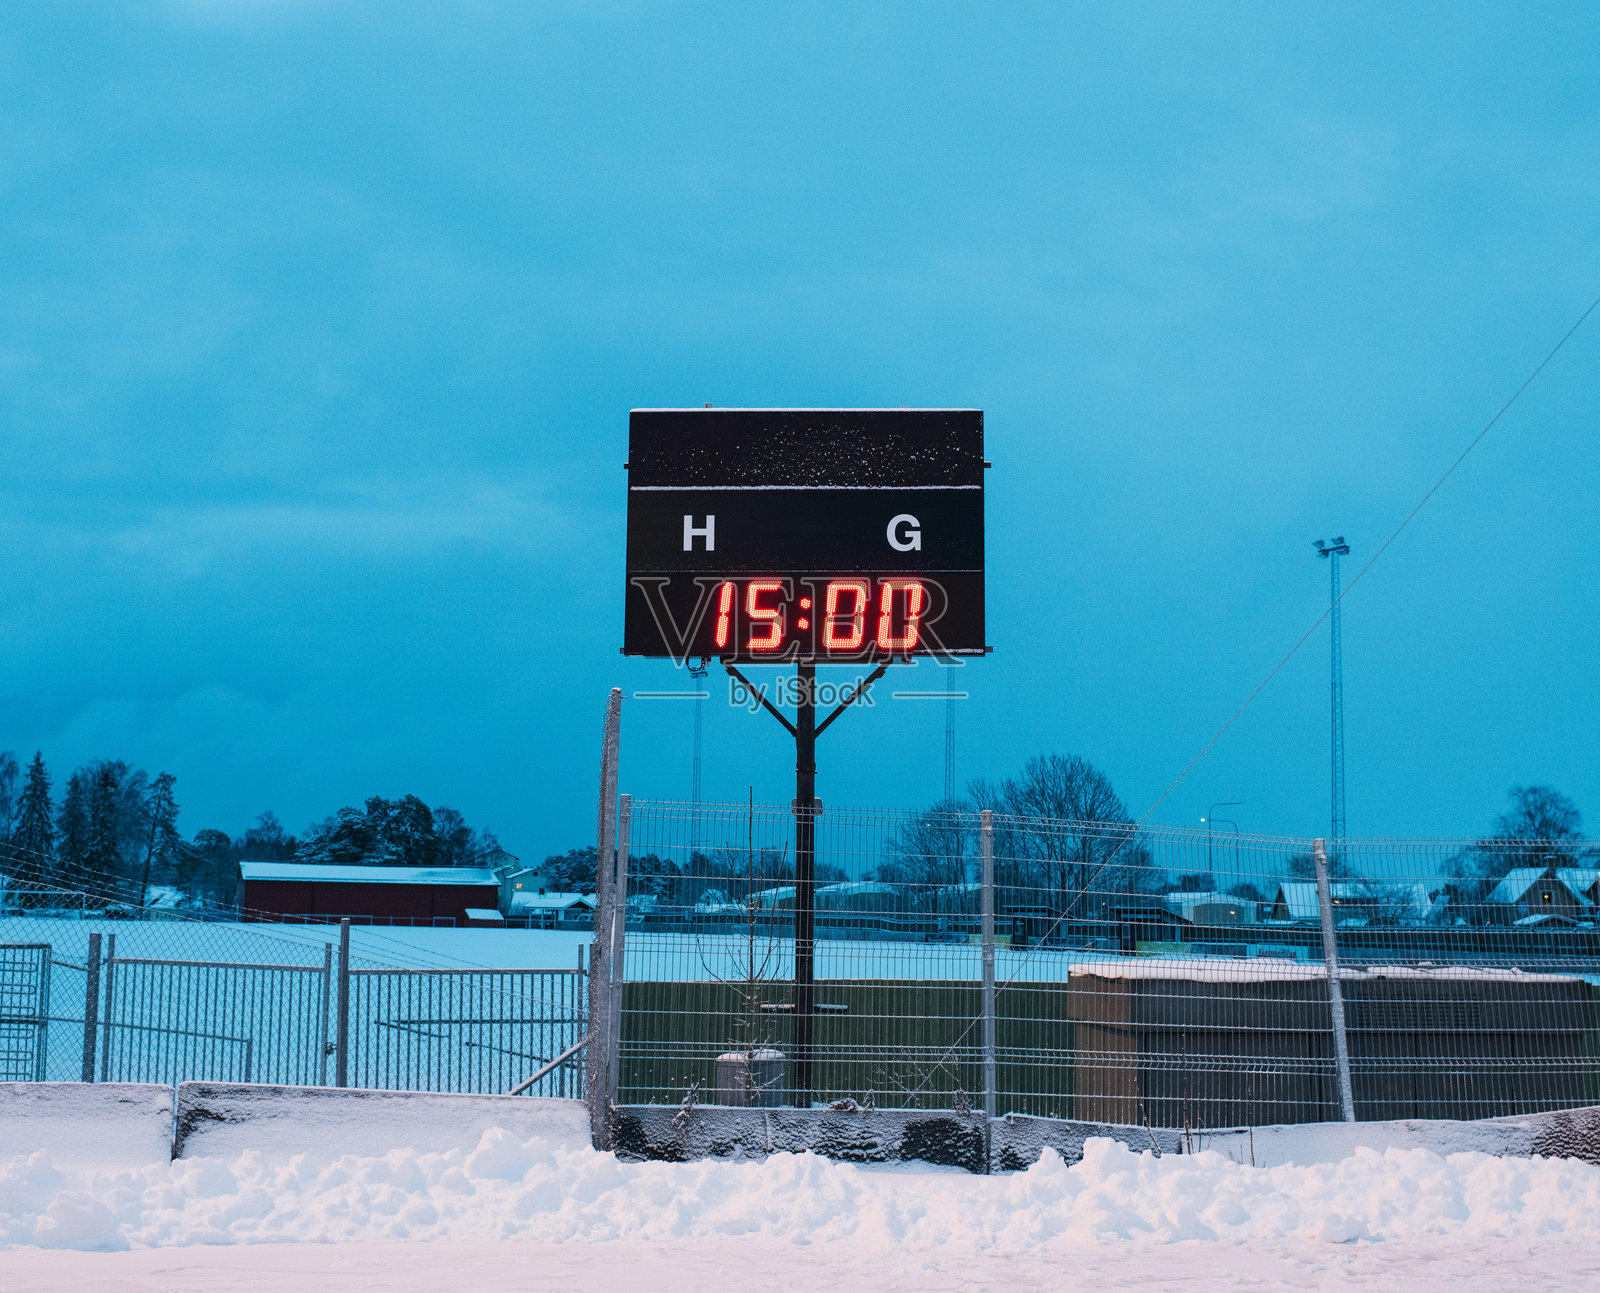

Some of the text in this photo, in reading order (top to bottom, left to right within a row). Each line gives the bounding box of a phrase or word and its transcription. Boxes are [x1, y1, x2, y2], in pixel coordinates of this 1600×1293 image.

[683, 515, 715, 551] H
[887, 514, 922, 551] G
[716, 579, 922, 648] 15:00
